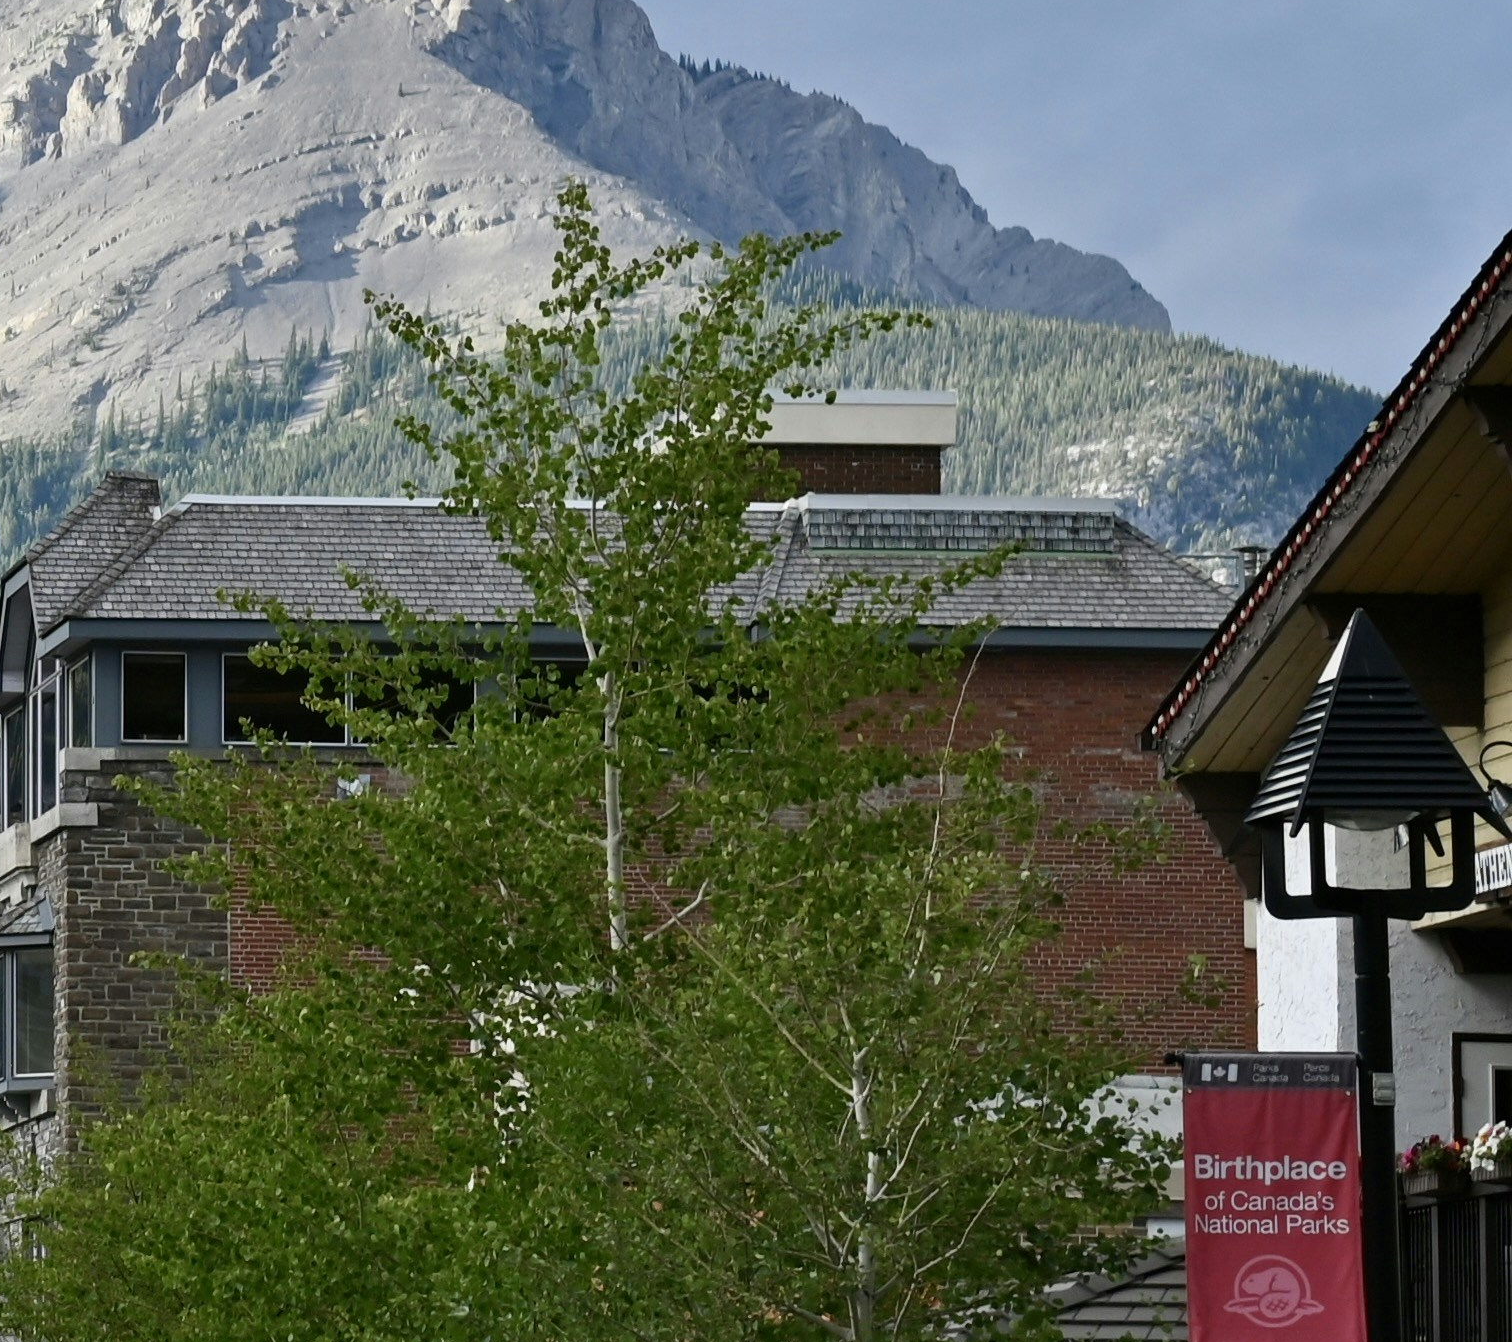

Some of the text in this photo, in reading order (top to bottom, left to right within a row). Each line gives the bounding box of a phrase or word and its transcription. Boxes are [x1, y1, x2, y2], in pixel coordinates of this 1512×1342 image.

[1194, 1154, 1347, 1186] Birthplace
[1204, 1190, 1335, 1211] of Canada's
[1194, 1214, 1350, 1234] National Parks
